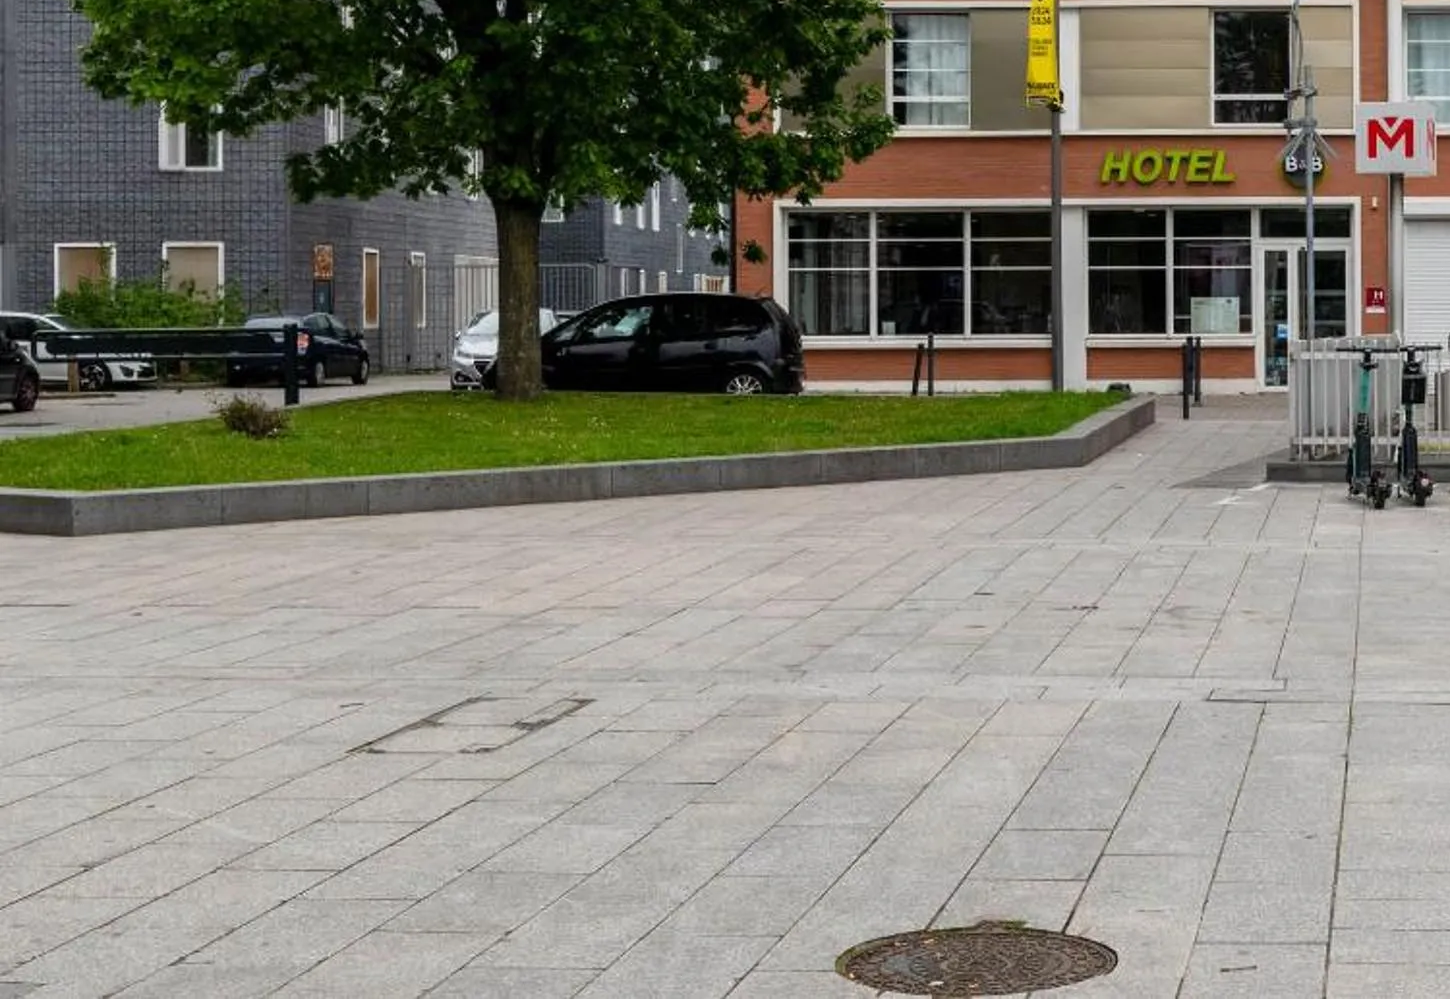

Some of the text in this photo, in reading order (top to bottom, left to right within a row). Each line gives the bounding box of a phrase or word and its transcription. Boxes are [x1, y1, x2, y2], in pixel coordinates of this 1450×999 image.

[1368, 116, 1414, 159] M
[1101, 148, 1237, 185] HOTEL
[1284, 155, 1324, 173] B&B
